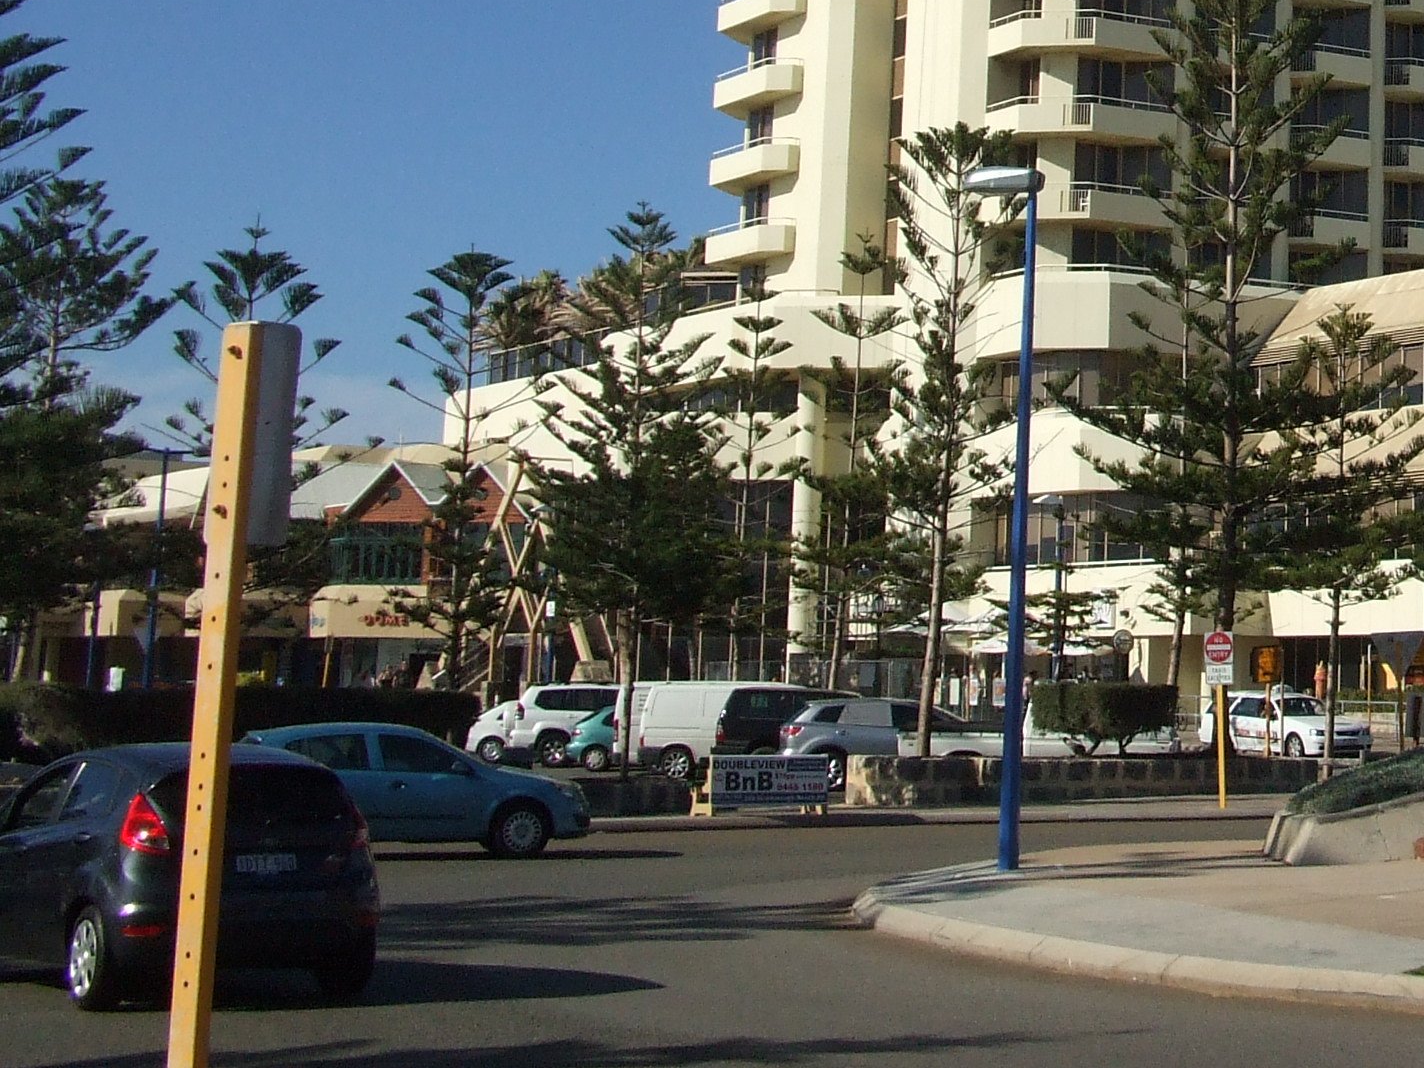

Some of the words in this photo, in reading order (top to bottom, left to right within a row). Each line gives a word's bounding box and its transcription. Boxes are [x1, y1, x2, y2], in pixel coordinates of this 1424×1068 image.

[1208, 651, 1230, 659] ENTRY
[713, 759, 786, 770] DOUBLEVIEW
[725, 771, 773, 791] BnB
